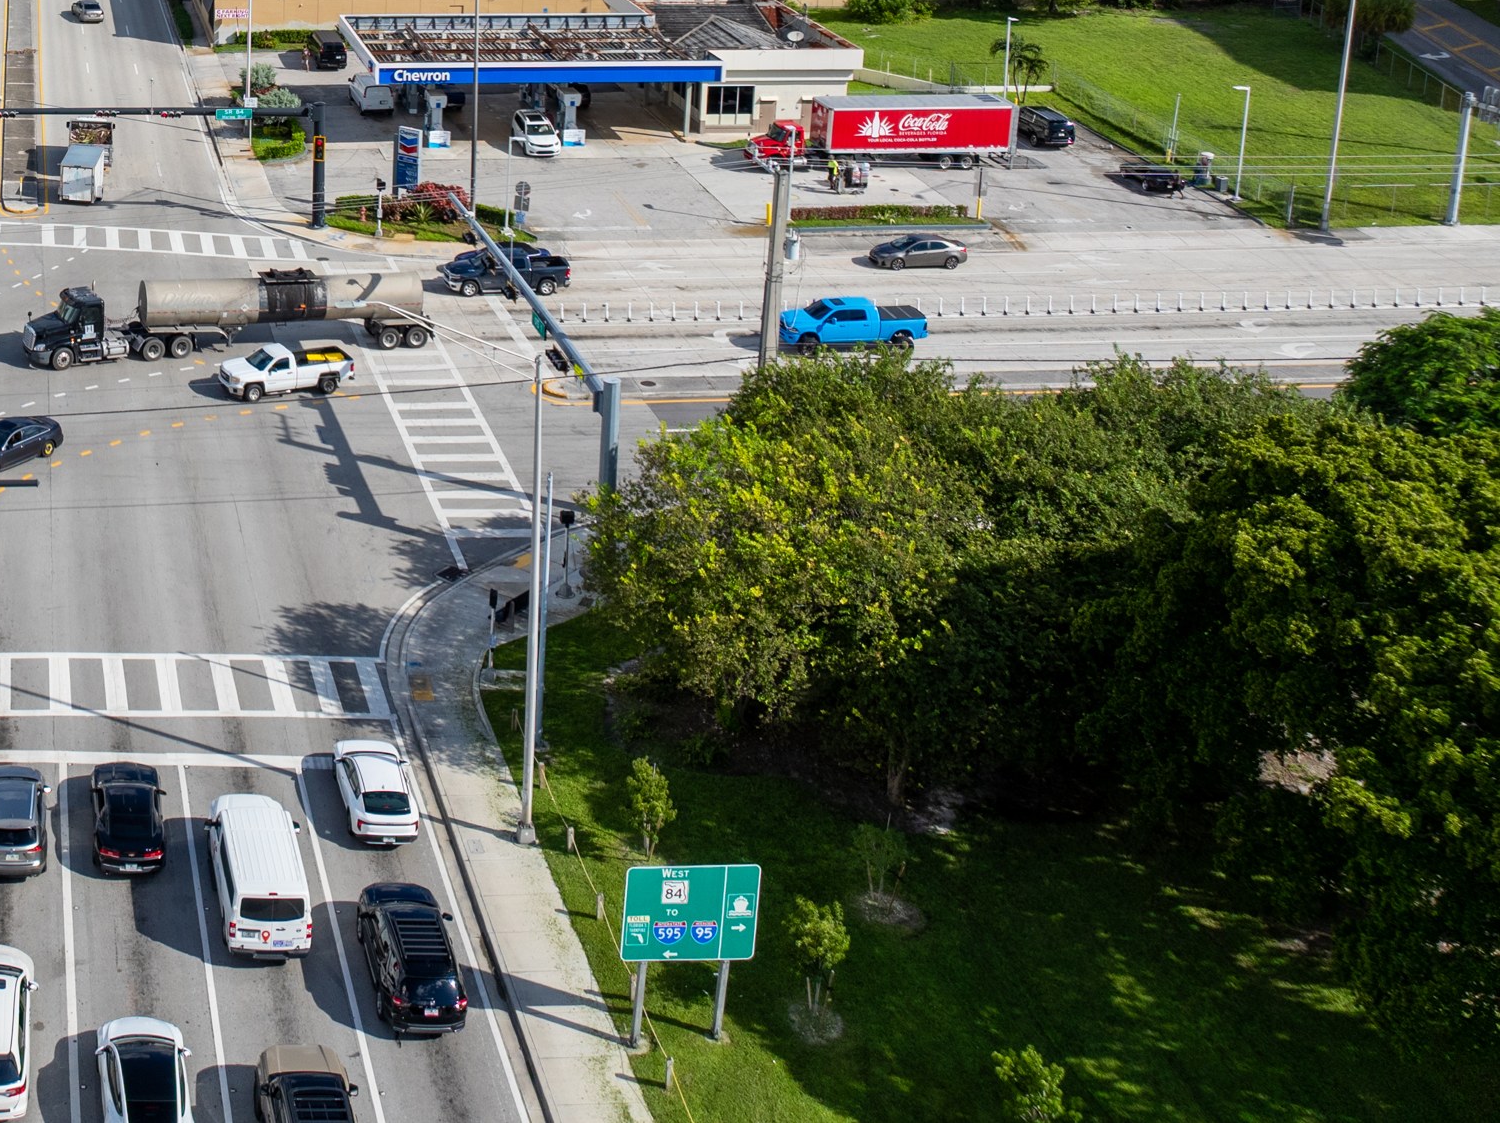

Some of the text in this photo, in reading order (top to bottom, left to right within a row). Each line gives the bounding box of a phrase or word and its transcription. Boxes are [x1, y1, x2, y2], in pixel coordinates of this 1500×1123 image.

[394, 69, 451, 82] Chevron
[899, 113, 952, 131] Coca-Cola
[662, 868, 690, 878] WEST
[665, 888, 683, 899] 84
[658, 928, 681, 939] 595
[695, 927, 713, 939] 95
